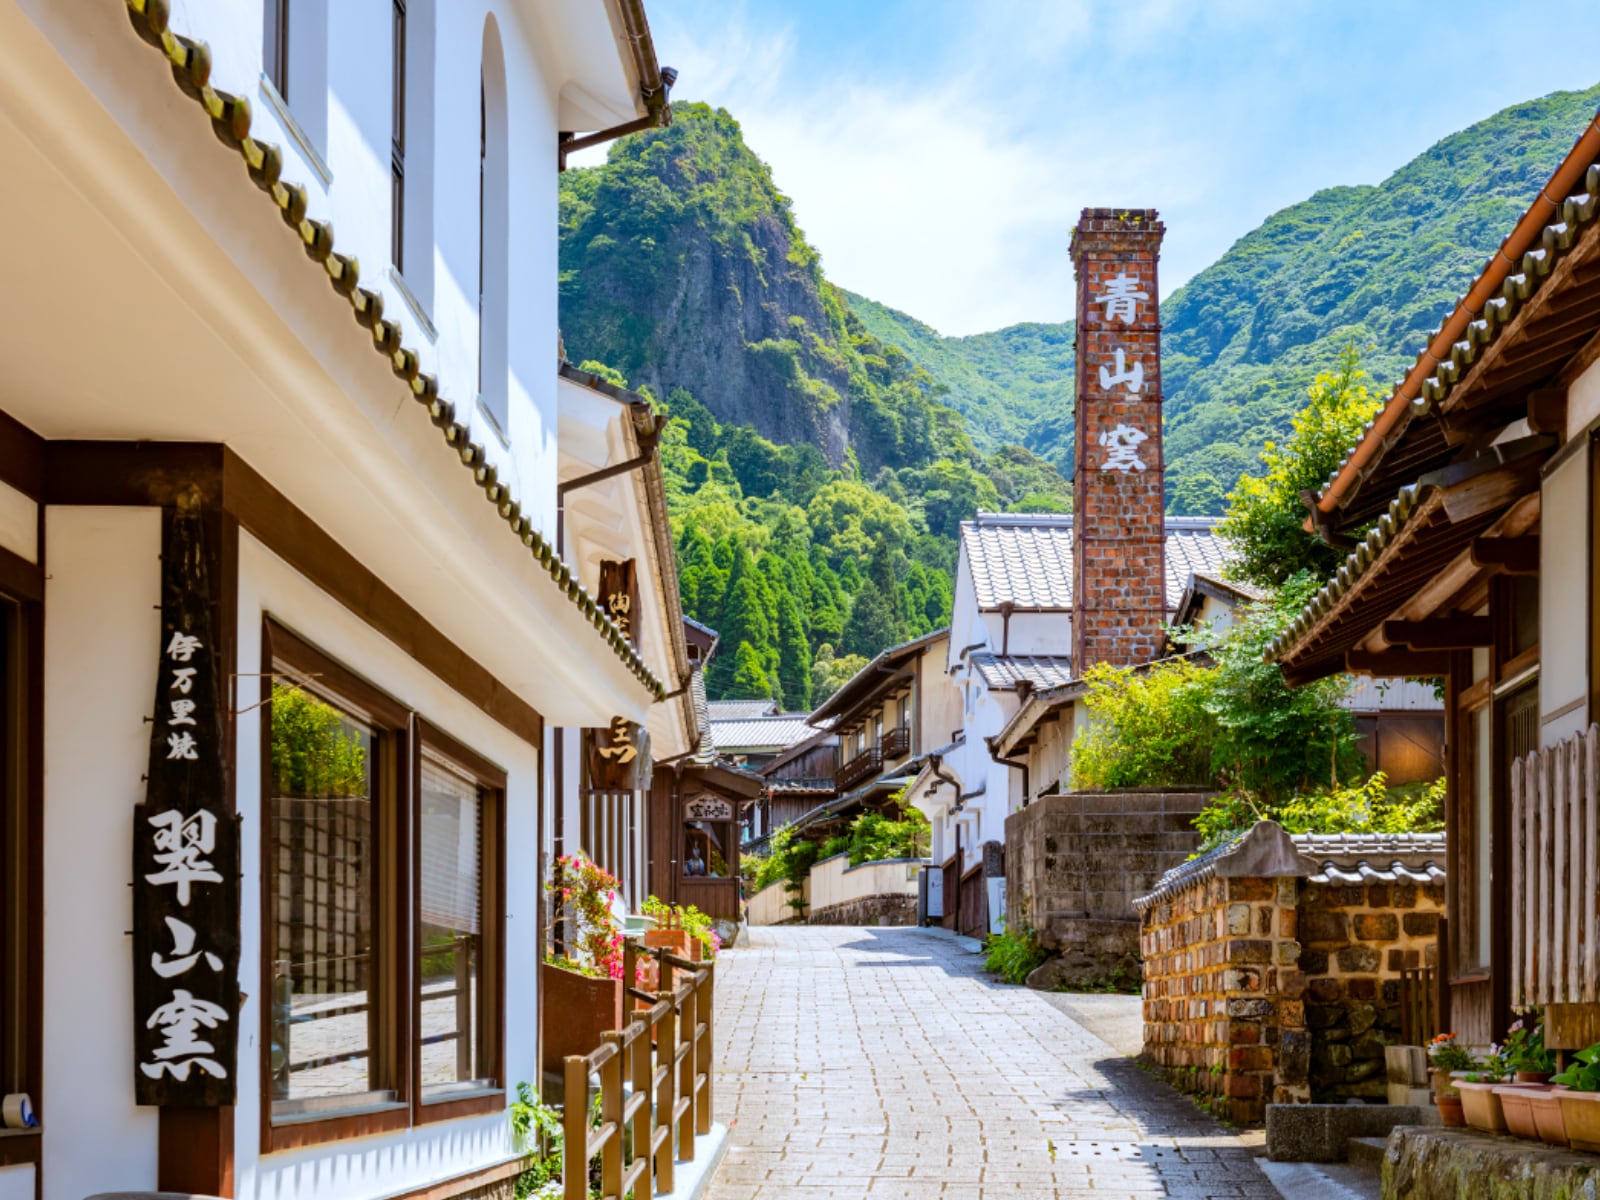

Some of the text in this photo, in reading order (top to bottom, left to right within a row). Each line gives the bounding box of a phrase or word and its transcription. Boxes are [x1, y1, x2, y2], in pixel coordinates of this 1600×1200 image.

[1096, 273, 1149, 474] 青山窯
[166, 631, 203, 760] 伊万里焼
